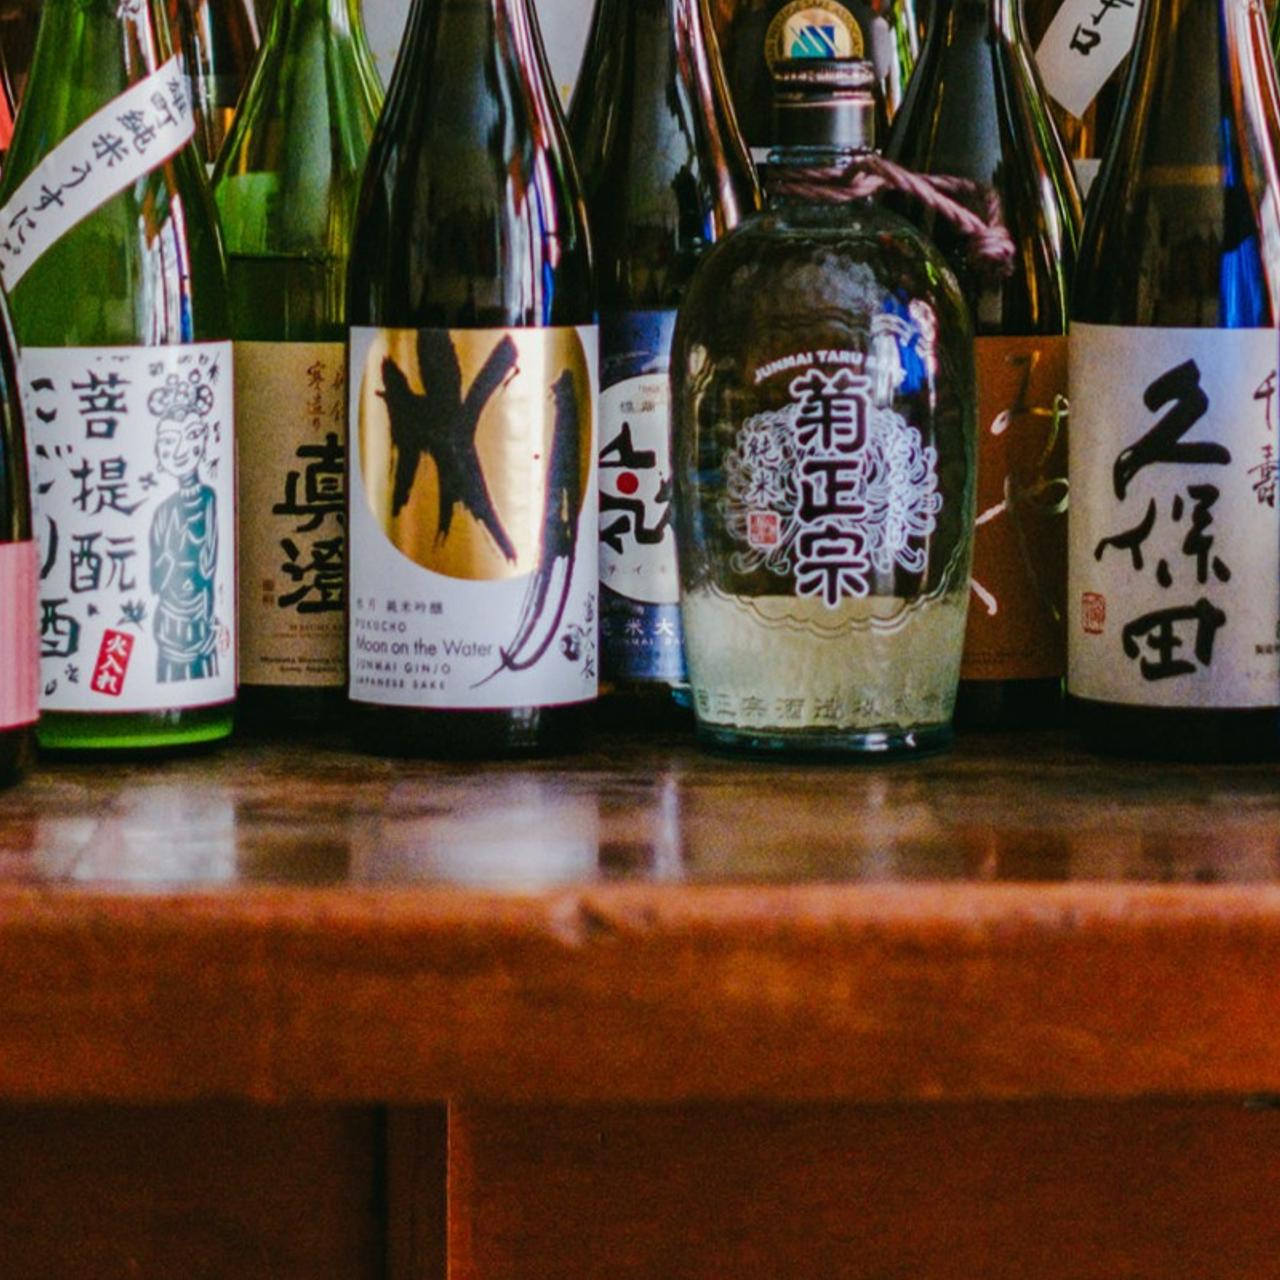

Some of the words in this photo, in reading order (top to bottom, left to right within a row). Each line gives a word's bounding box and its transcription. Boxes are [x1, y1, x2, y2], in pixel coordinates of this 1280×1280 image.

[754, 350, 814, 385] JUNMAI
[790, 368, 872, 610] 菊正宗
[1095, 357, 1232, 683] 久保田
[356, 633, 388, 654] Moon
[391, 637, 408, 654] on
[413, 637, 437, 656] the
[442, 639, 492, 658] Water
[356, 676, 405, 689] JAPANESE
[412, 678, 446, 690] SAKE
[404, 661, 451, 675] GINJO
